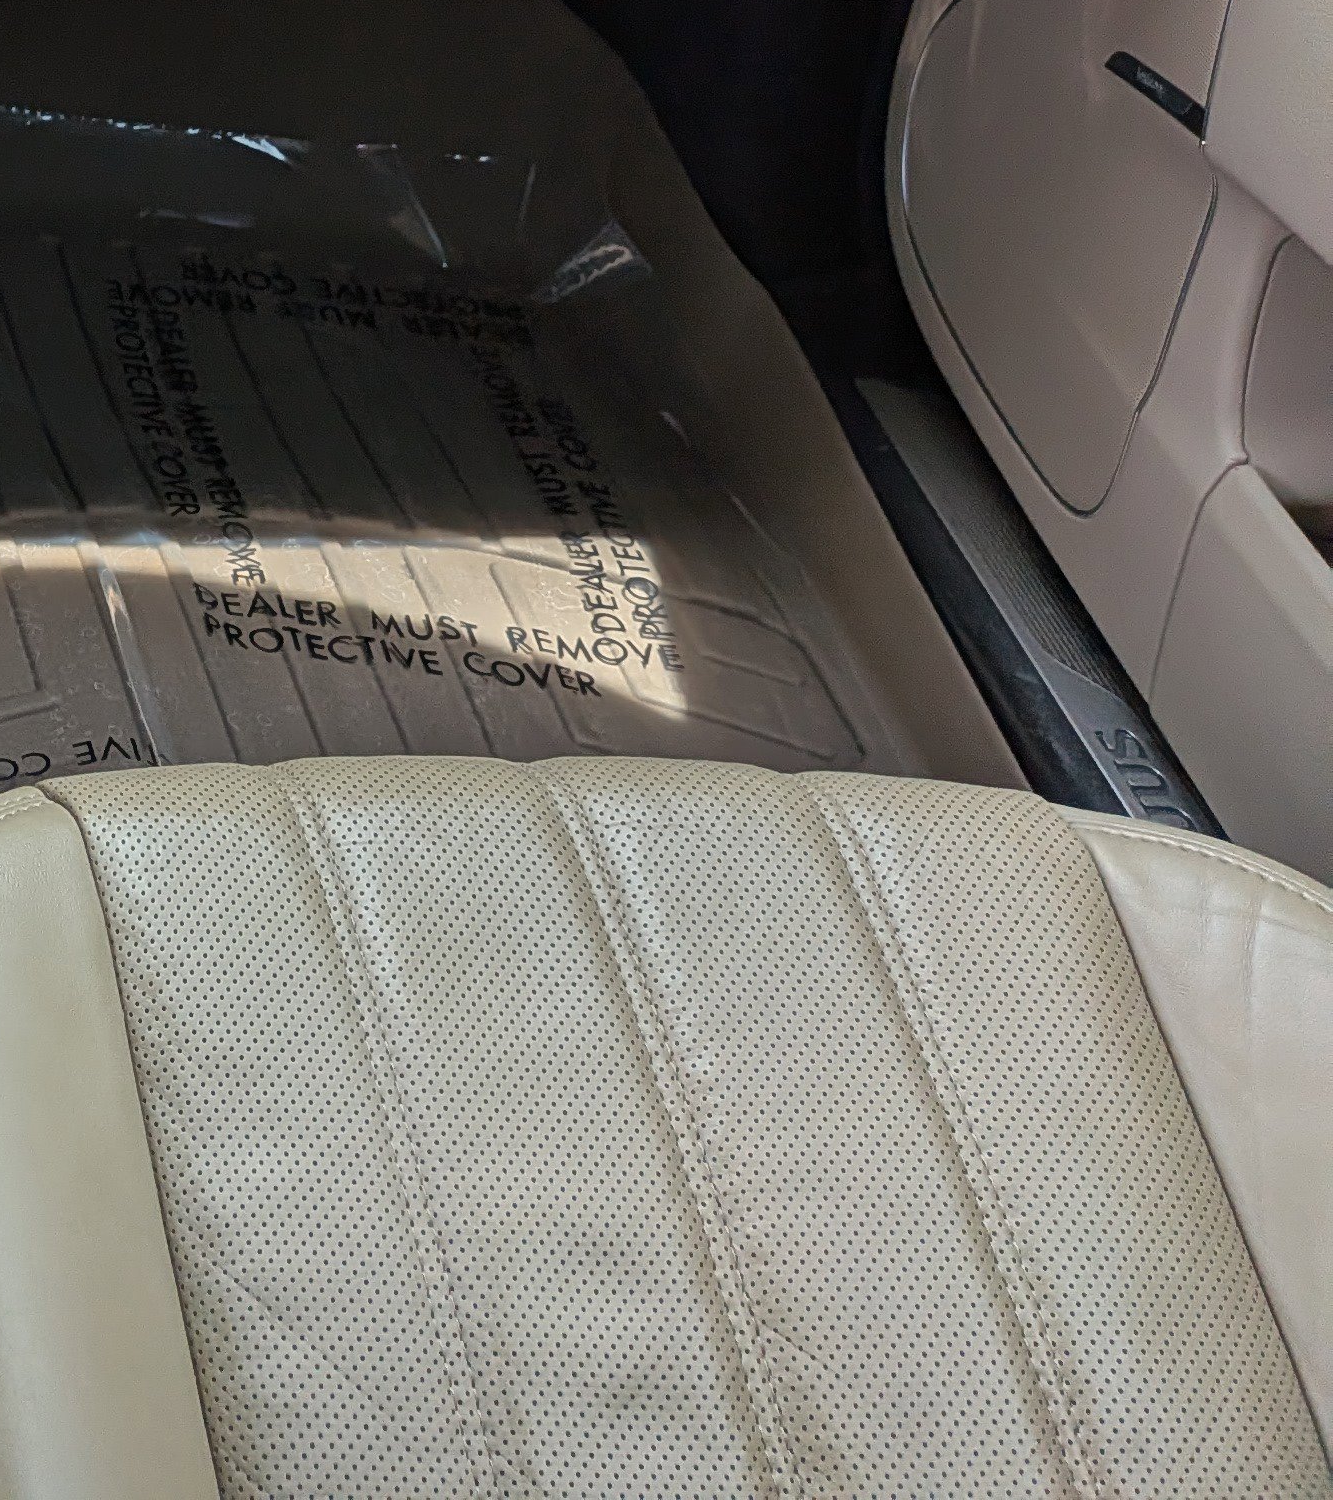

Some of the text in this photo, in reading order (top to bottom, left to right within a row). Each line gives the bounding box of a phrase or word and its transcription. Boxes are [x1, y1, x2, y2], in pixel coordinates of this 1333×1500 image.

[194, 582, 685, 673] DEALER MUST REMOVE
[204, 610, 604, 699] PROTECTIVE COVER
